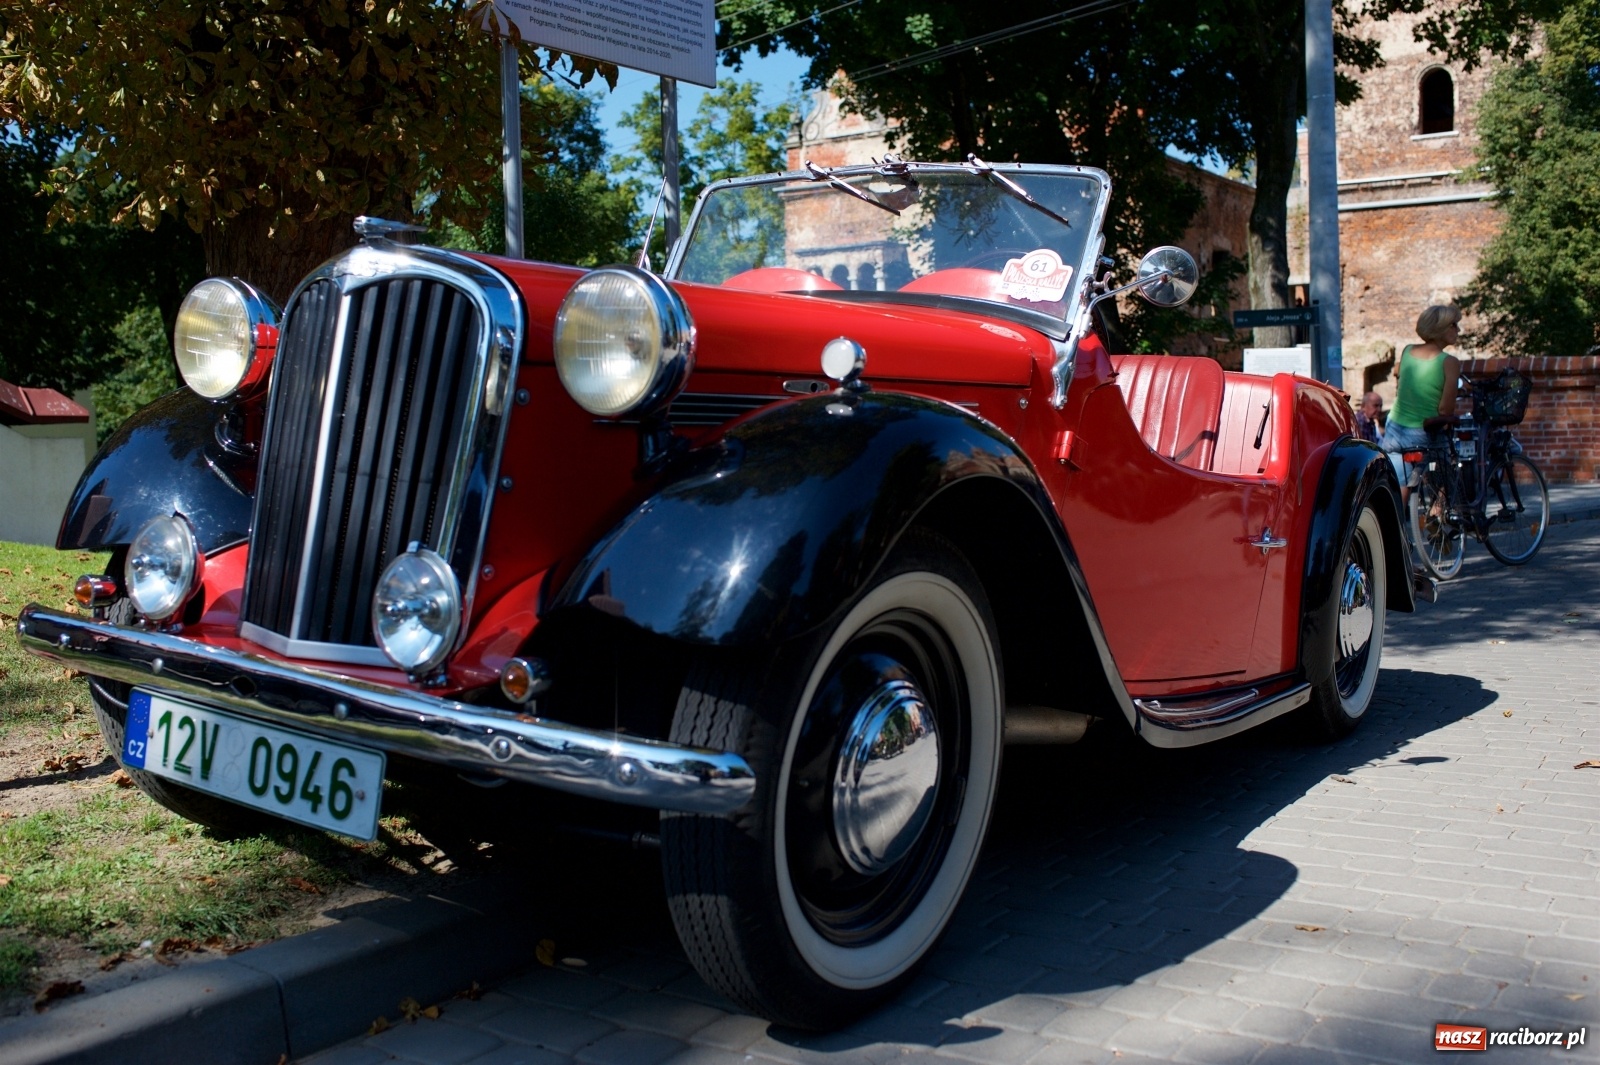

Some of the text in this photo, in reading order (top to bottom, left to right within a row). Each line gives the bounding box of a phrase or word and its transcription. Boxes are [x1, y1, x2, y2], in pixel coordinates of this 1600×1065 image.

[553, 1, 581, 13] techniczne
[511, 1, 532, 11] ramach
[560, 13, 592, 27] Podstawowe
[612, 28, 630, 37] odnowa
[529, 15, 556, 29] Programu
[557, 23, 579, 35] Rozwoju
[1030, 259, 1048, 272] 61
[128, 739, 145, 759] CZ
[157, 710, 357, 821] 12V 0946
